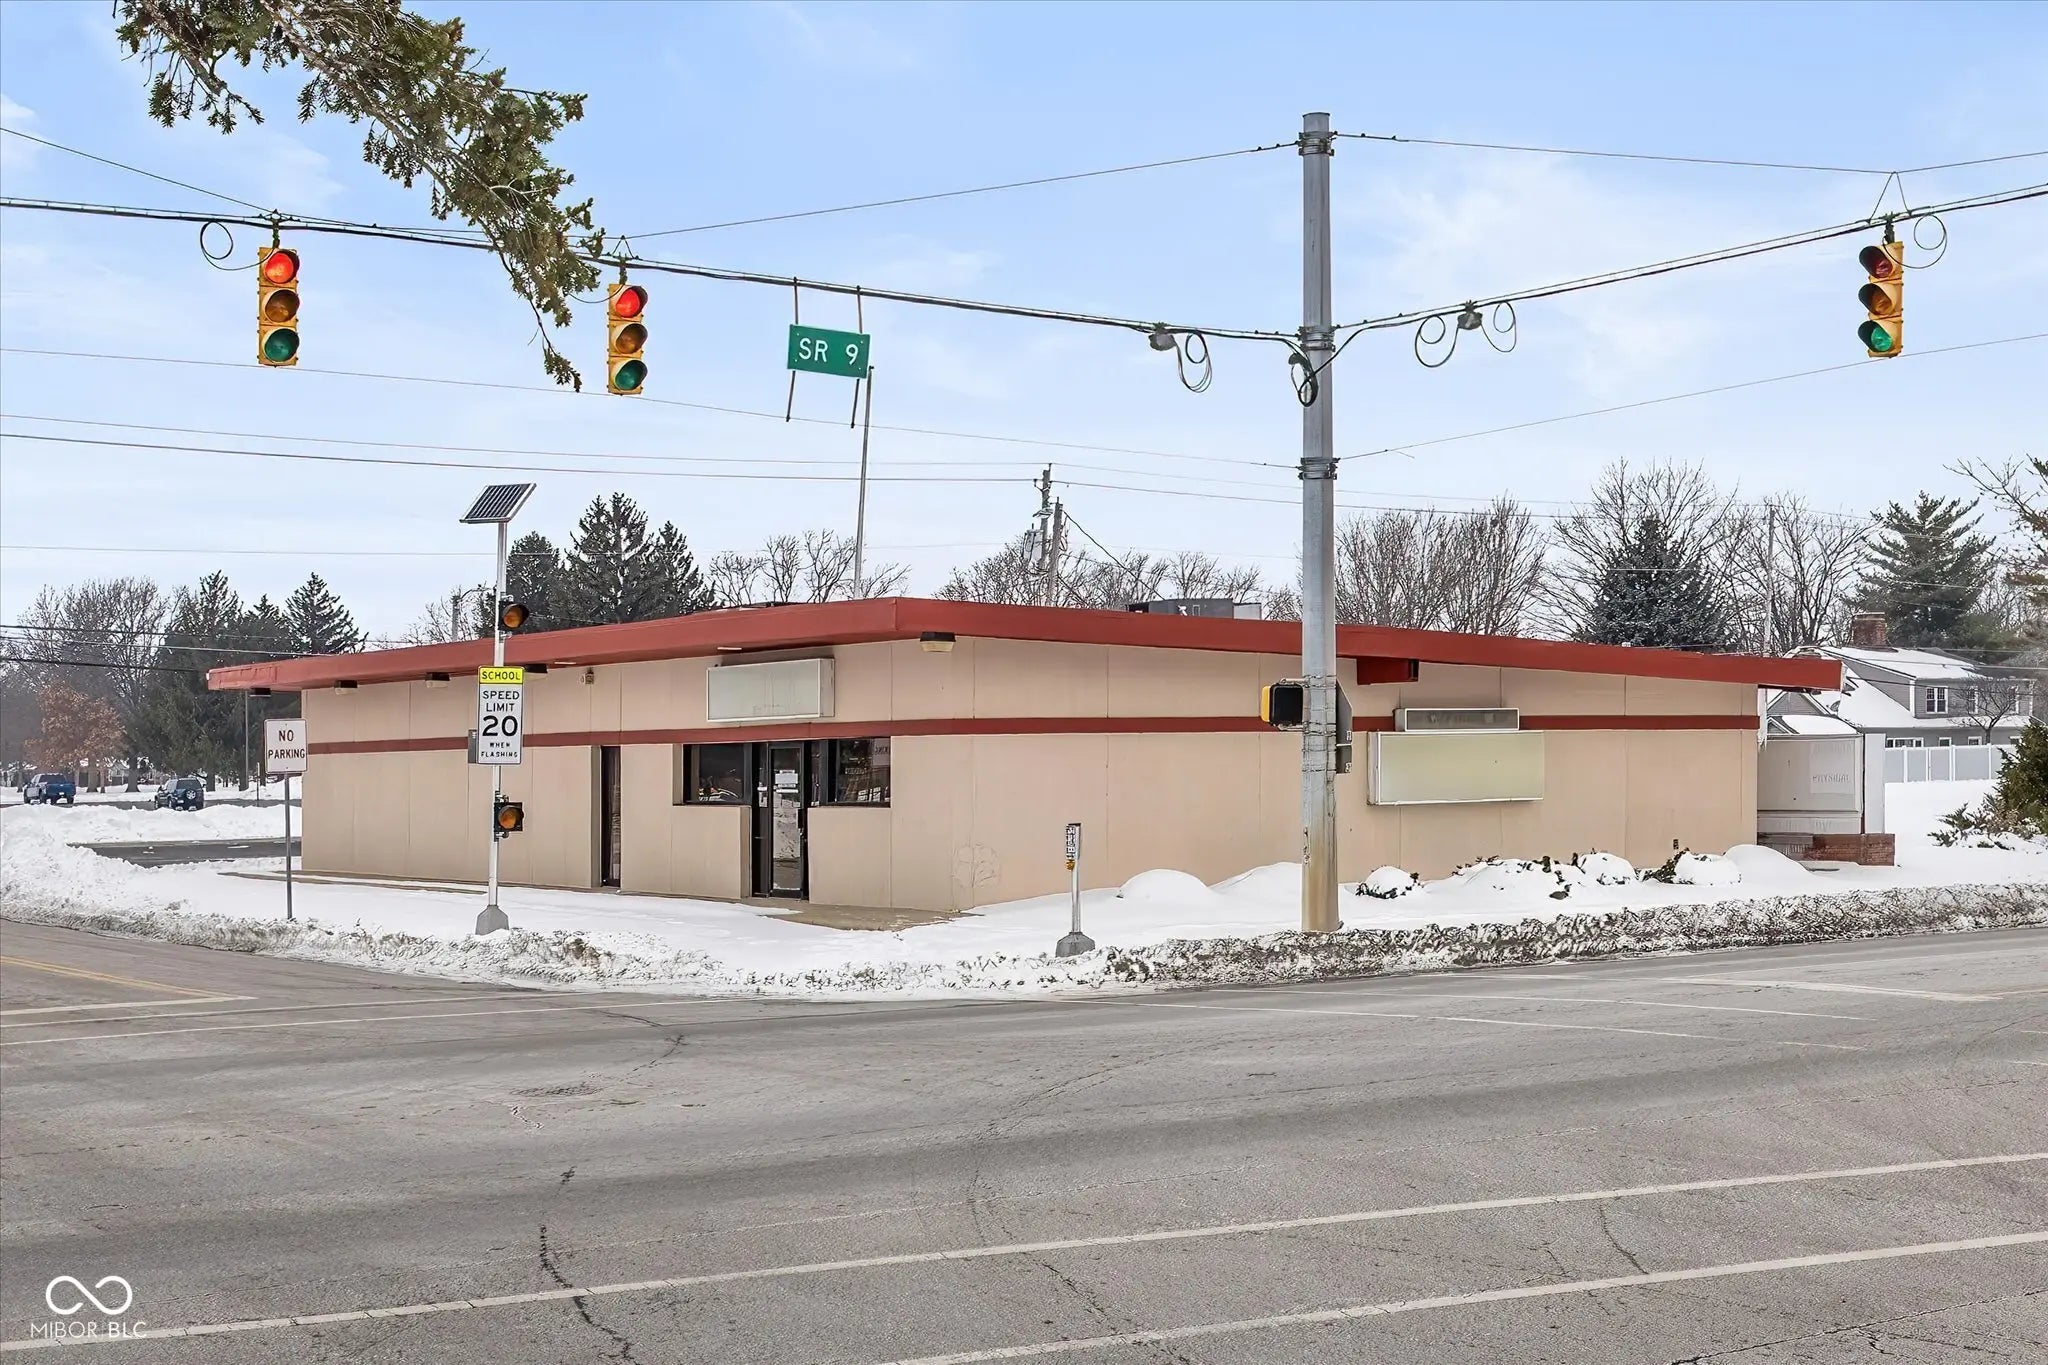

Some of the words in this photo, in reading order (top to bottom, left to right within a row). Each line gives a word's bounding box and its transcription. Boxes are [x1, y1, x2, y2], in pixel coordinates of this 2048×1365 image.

[799, 337, 828, 363] SR
[845, 343, 859, 366] 9
[481, 671, 521, 680] SCHOOL
[482, 690, 520, 700] SPEED
[486, 702, 515, 712] LIMIT
[482, 715, 518, 737] 20
[278, 729, 294, 742] NO
[268, 748, 306, 759] PARKING
